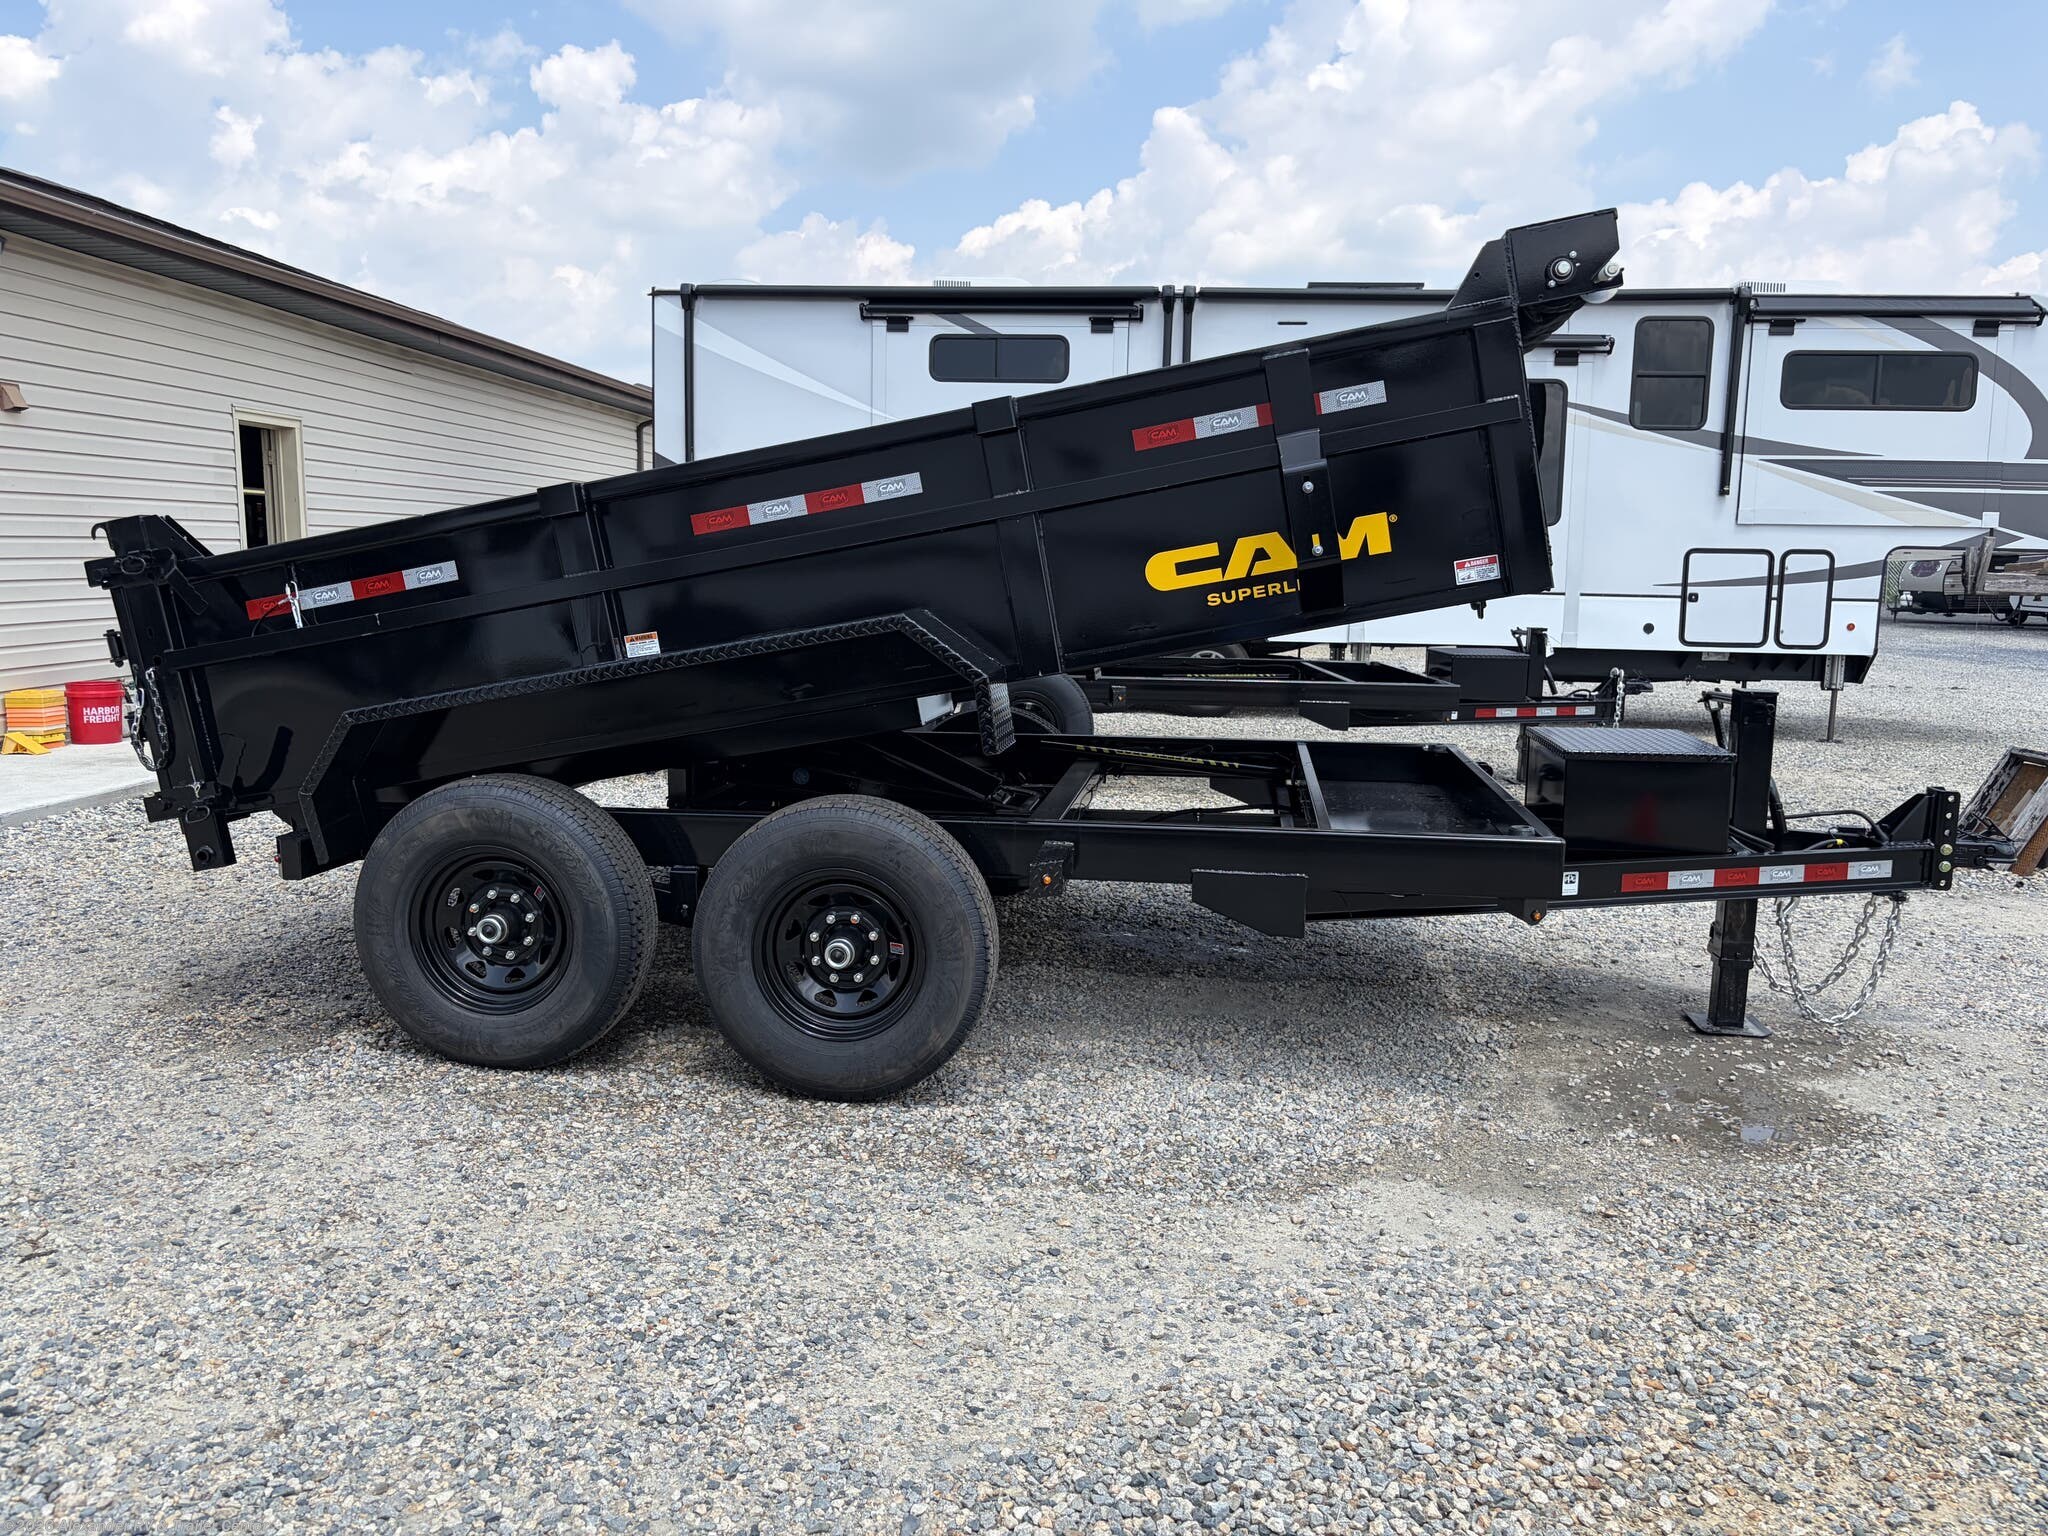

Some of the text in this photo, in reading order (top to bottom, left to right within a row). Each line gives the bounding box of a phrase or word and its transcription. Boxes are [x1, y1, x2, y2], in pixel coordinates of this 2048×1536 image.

[1339, 391, 1366, 405] CAM
[1213, 416, 1240, 428] CAM
[1150, 429, 1177, 441] CAM
[879, 481, 904, 493] CAM
[765, 502, 789, 514] CAM
[419, 569, 442, 580] CAM
[314, 590, 338, 602] CAM
[83, 706, 119, 715] HARBOR
[84, 714, 119, 724] FREIGHT
[1773, 871, 1791, 879] CAM
[1861, 866, 1879, 874] CAM
[1682, 876, 1701, 884] CAM
